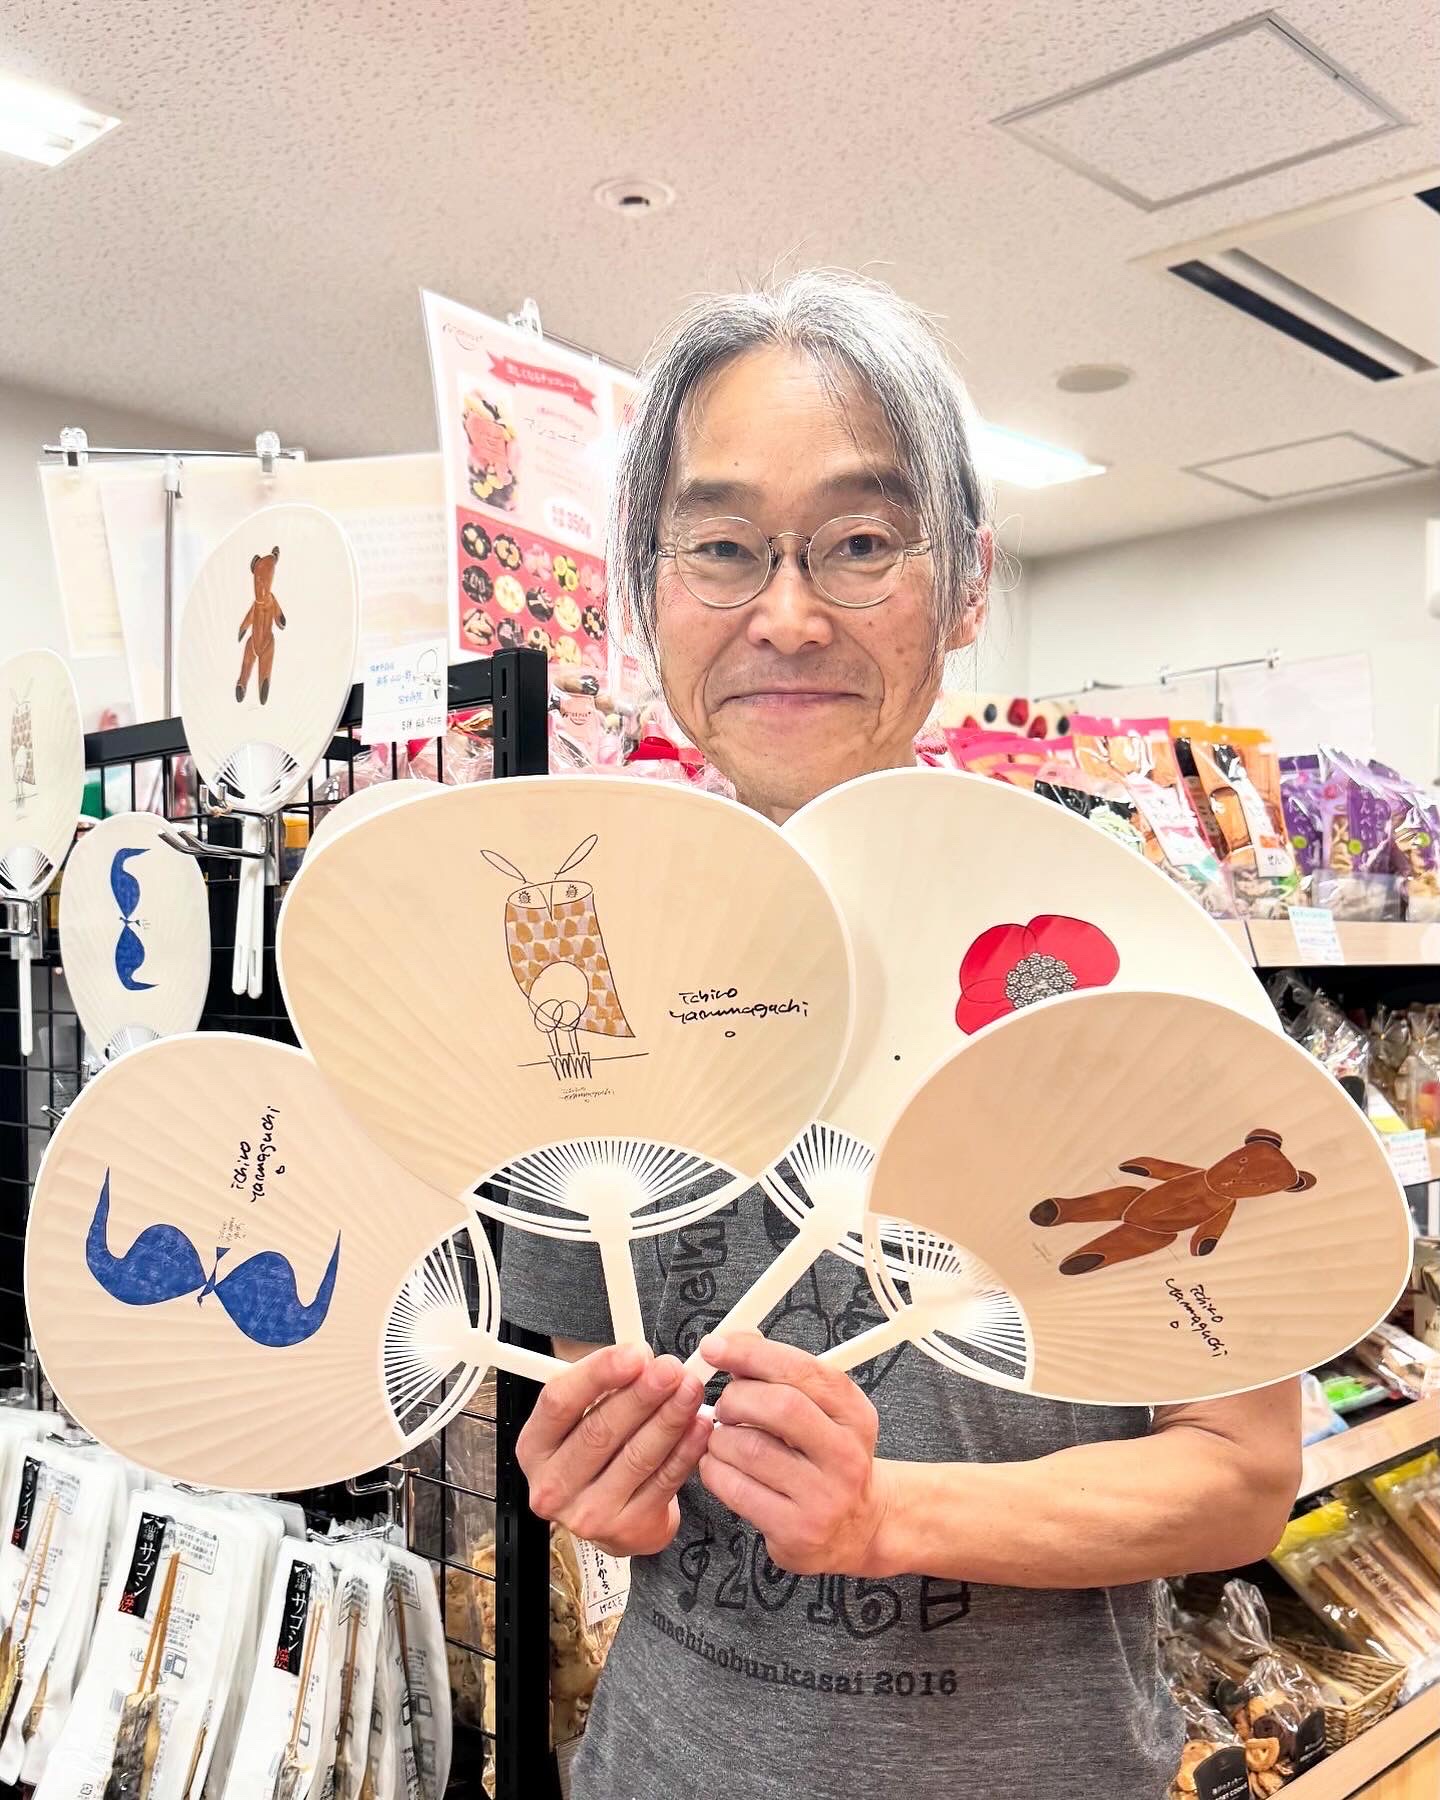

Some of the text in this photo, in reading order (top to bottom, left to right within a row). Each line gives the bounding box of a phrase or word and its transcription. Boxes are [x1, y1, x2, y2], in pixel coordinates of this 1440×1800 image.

[134, 1541, 157, 1598] サゴシ
[653, 1608, 958, 1697] machinobunkasai 2016
